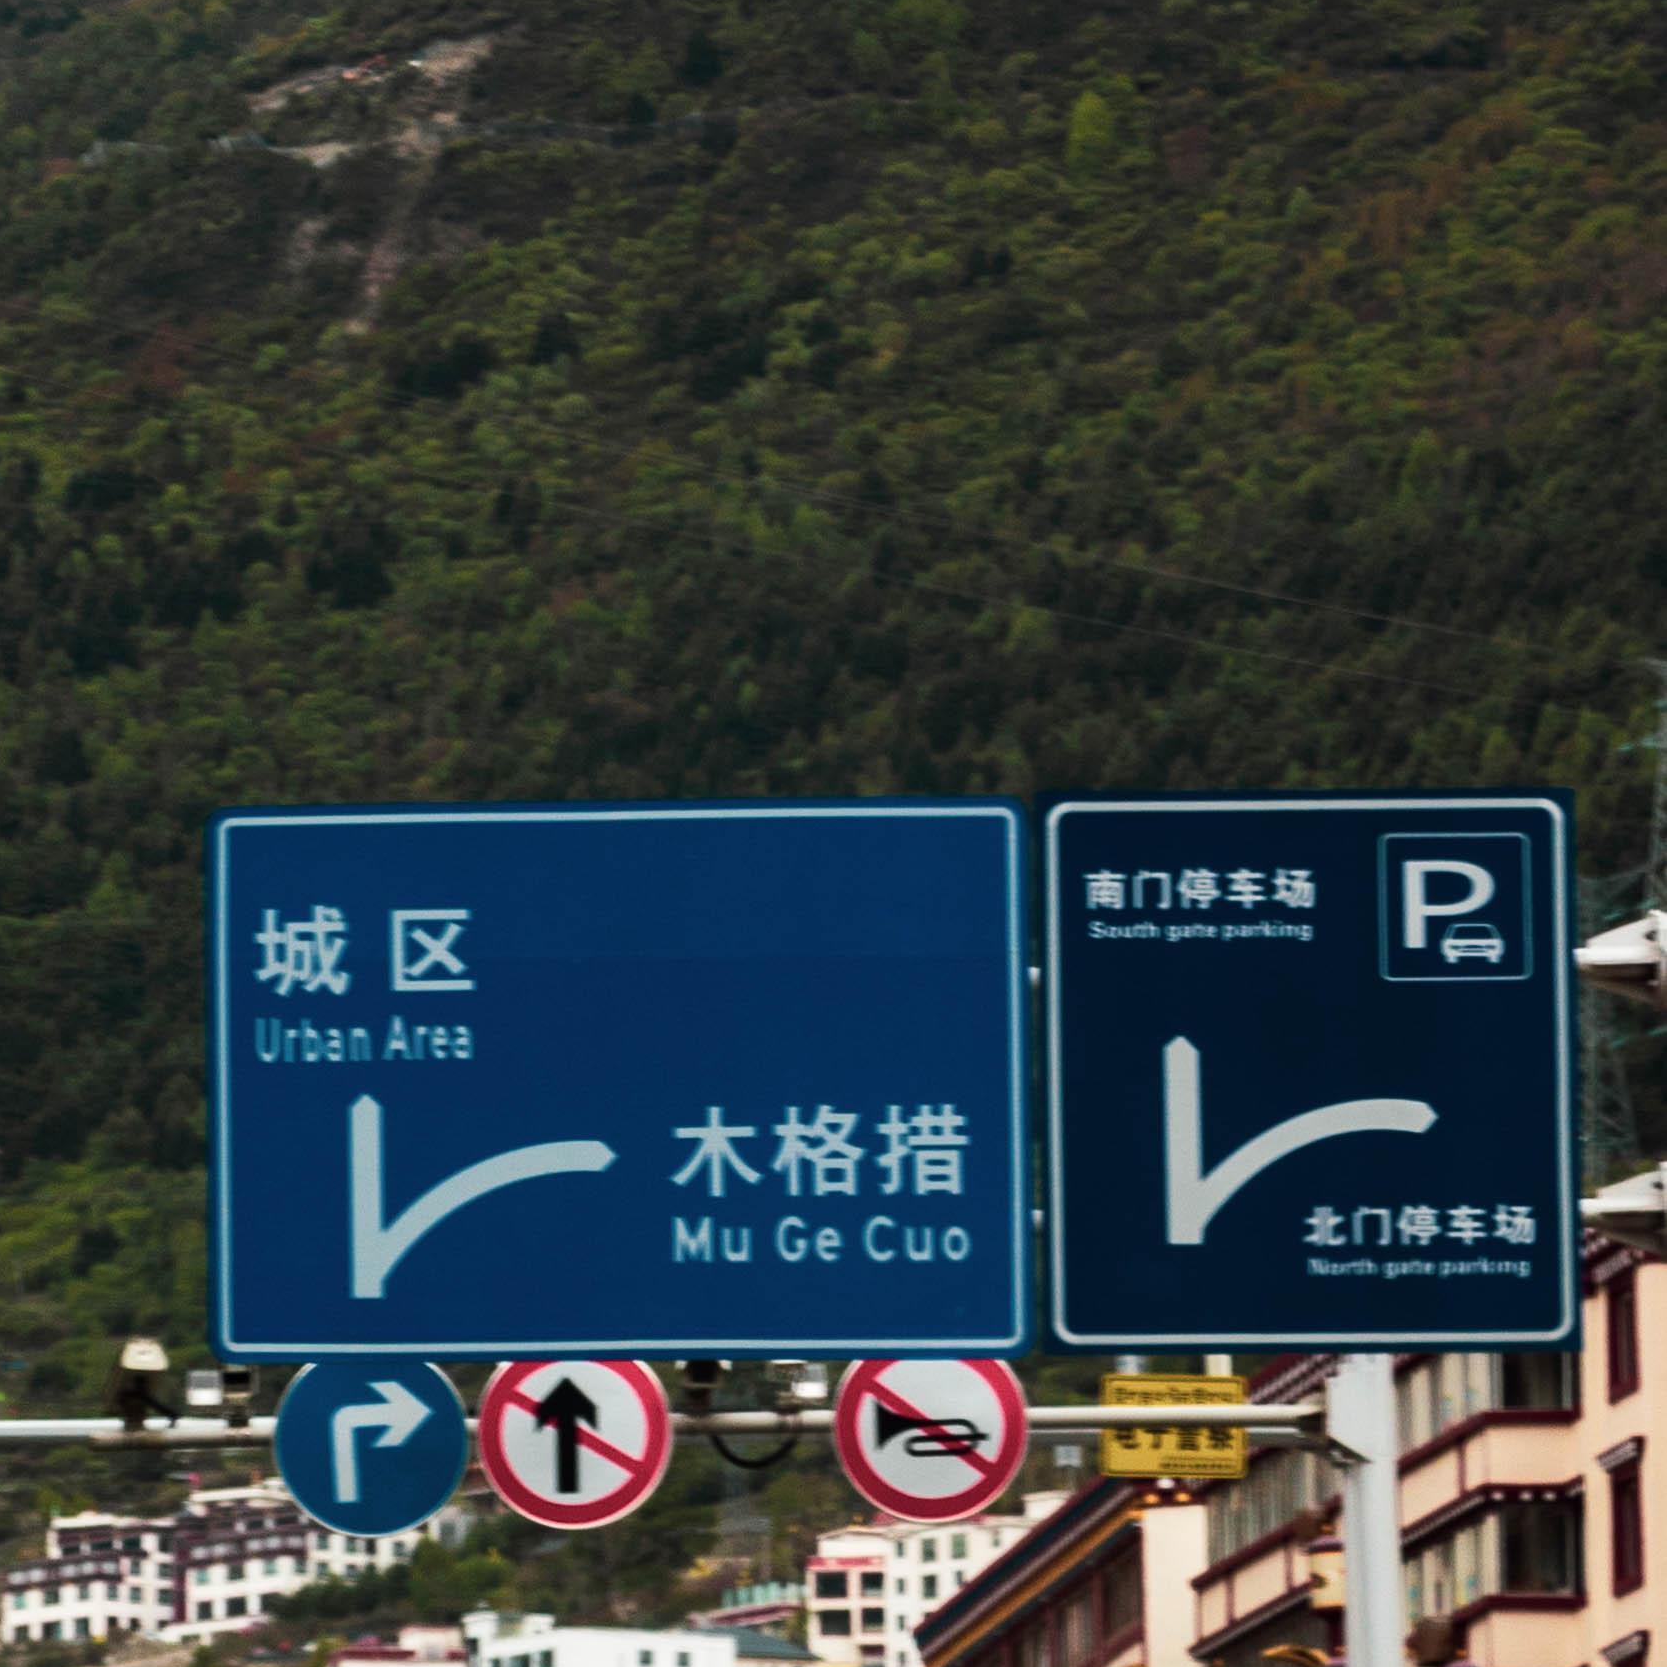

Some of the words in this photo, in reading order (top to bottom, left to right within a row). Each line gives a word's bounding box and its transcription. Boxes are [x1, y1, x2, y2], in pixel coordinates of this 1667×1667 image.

[1083, 868, 1316, 909] 南门停车场
[1402, 860, 1495, 949] P
[254, 904, 476, 996] 城区
[1088, 920, 1162, 939] South
[1165, 924, 1219, 942] gate
[1221, 921, 1314, 942] parking
[255, 1018, 372, 1062] Urban
[383, 1016, 474, 1061] Area
[671, 1104, 971, 1197] 木格措
[673, 1217, 750, 1263] Mu
[775, 1215, 843, 1262] Ge
[865, 1216, 971, 1263] Cuo
[1303, 1205, 1536, 1246] 北门停车场
[1307, 1258, 1378, 1276] North
[1384, 1261, 1436, 1279] gate
[1438, 1258, 1532, 1278] parking
